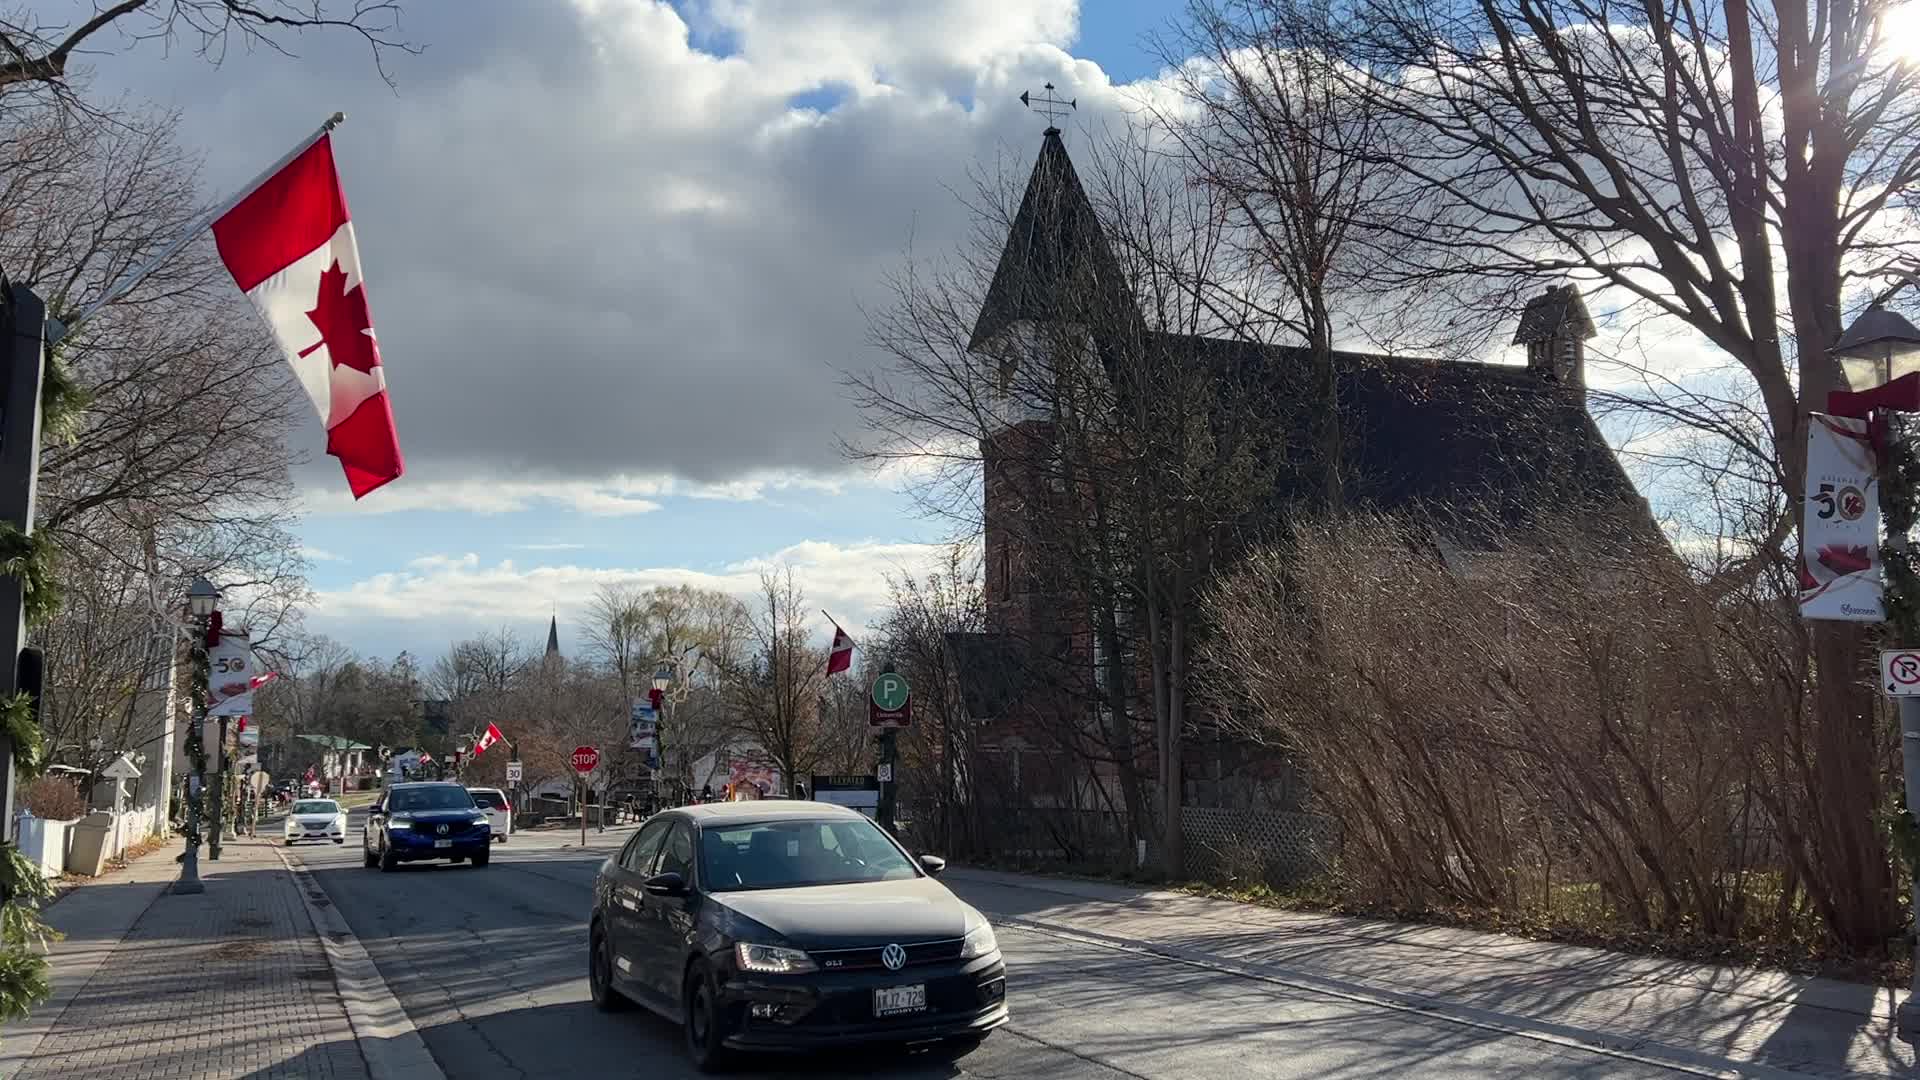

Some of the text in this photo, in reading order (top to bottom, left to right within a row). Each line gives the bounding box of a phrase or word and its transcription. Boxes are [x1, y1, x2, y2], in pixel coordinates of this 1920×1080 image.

[883, 679, 898, 700] P
[572, 753, 597, 766] STOP
[508, 769, 520, 779] 30
